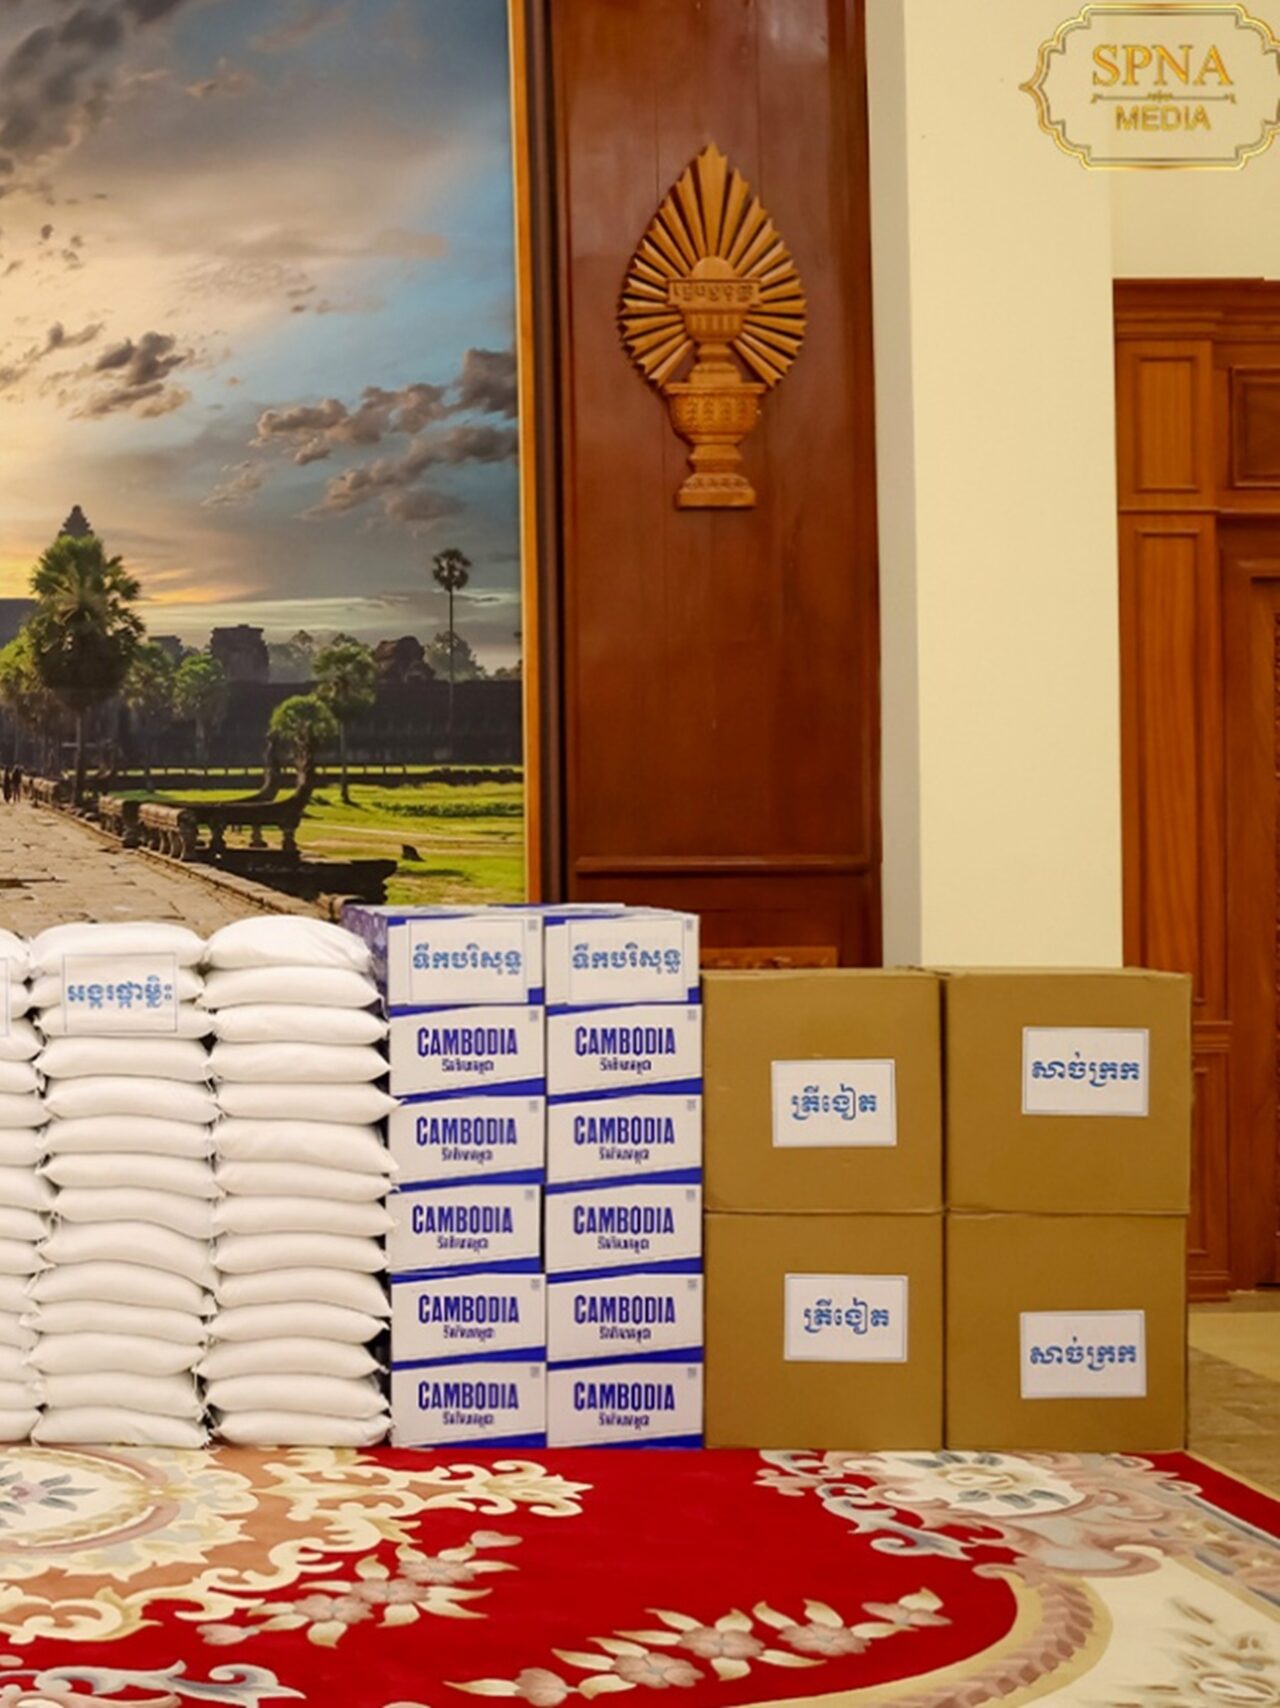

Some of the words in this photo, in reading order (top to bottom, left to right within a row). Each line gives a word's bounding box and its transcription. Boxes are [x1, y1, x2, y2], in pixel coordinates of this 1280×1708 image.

[412, 942, 522, 975] ទឹកបរិសុទ្ធ
[572, 941, 681, 974] ទឹកបរិសុទ្ធ
[417, 1026, 518, 1058] CAMBODIA
[575, 1026, 676, 1057] CAMBODIA
[1032, 1051, 1140, 1088] សាច់ក្រក
[791, 1083, 877, 1121] ត្រីងៀត
[416, 1116, 518, 1147] CAMBODIA
[573, 1115, 675, 1146] CAMBODIA
[412, 1204, 514, 1235] CAMBODIA
[573, 1205, 675, 1236] CAMBODIA
[418, 1294, 520, 1324] CAMBODIA
[574, 1294, 676, 1325] CAMBODIA
[803, 1297, 889, 1335] ត្រីងៀត
[1029, 1336, 1137, 1372] សាច់ក្រក
[418, 1380, 519, 1411] CAMBODIA
[573, 1381, 676, 1412] CAMBODIA
